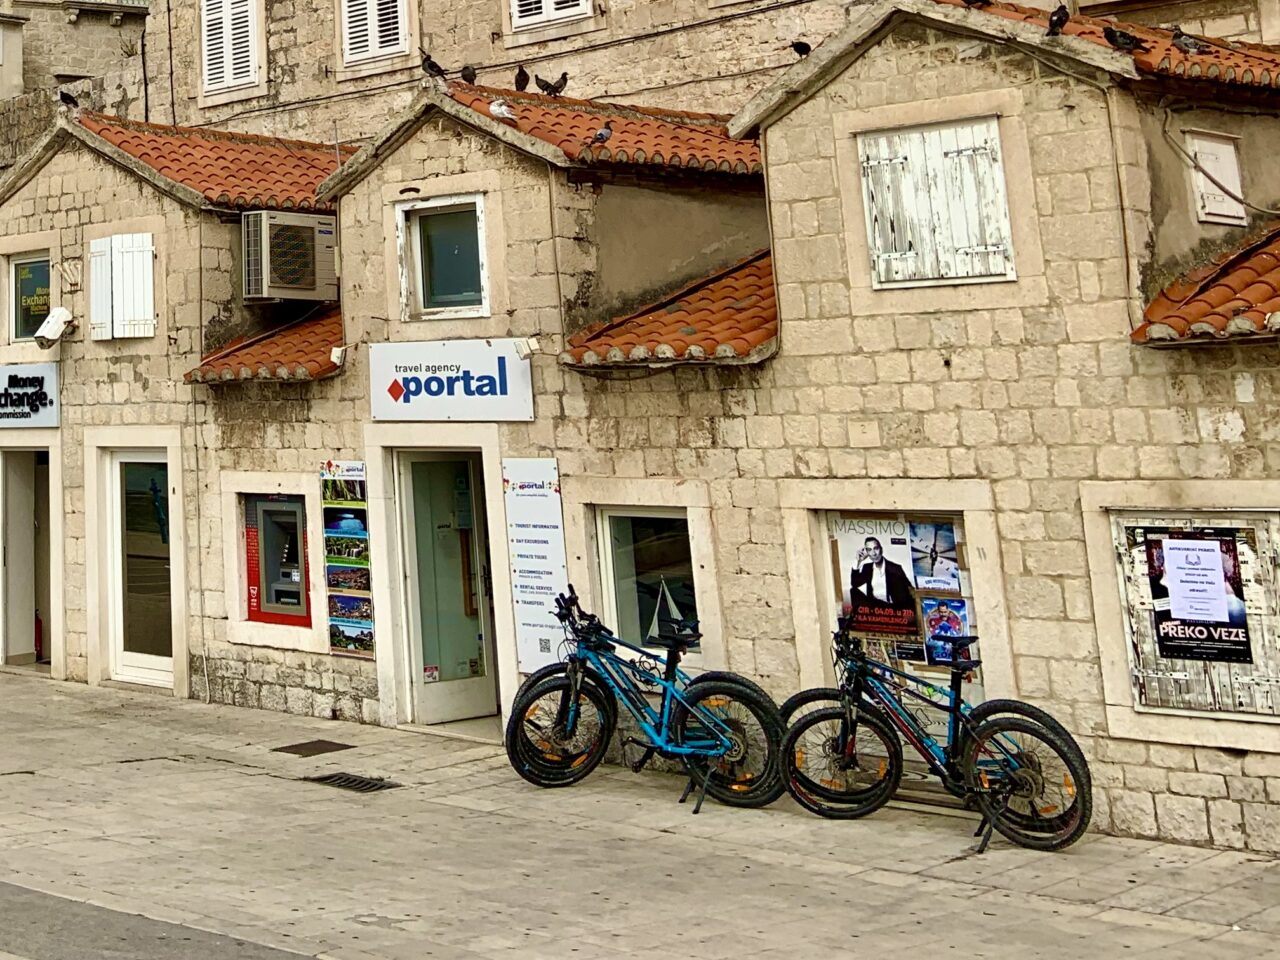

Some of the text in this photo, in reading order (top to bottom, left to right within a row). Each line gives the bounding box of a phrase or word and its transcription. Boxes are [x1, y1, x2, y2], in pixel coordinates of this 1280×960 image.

[395, 363, 461, 375] travel agency
[8, 374, 45, 391] Money
[402, 356, 508, 403] portal
[834, 519, 907, 536] MASSIMO
[1159, 624, 1247, 641] PREKO VEZE
